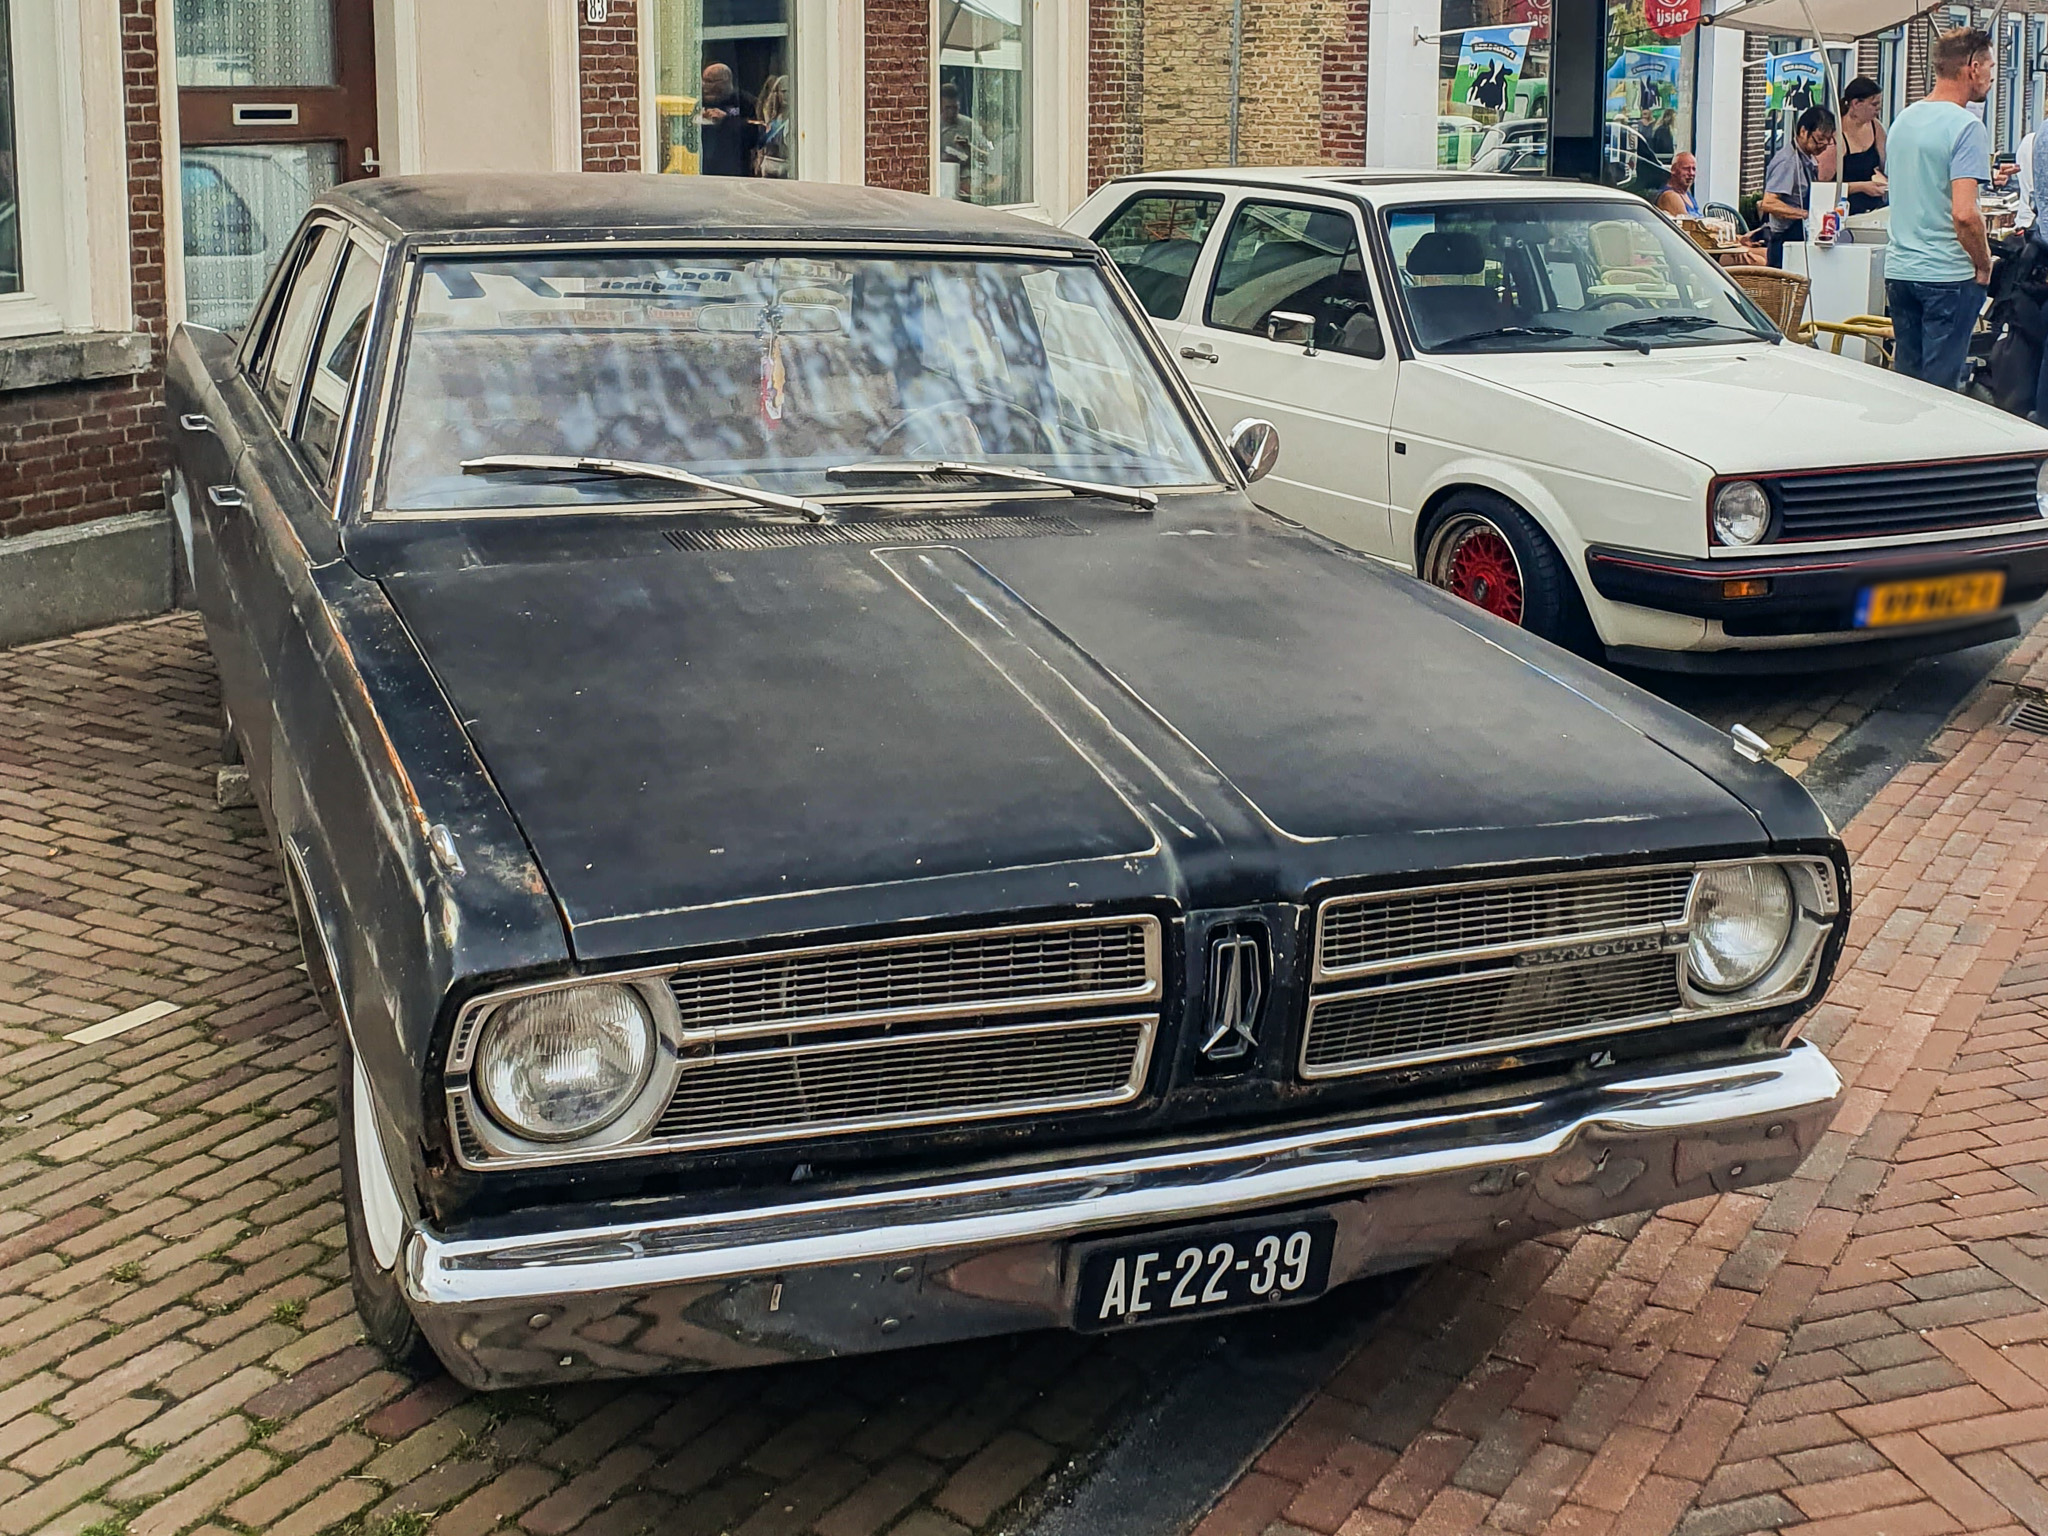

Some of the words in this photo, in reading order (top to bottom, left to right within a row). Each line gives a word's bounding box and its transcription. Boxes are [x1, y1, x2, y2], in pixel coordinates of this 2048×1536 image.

[590, 0, 604, 19] 83
[1656, 8, 1689, 27] ijsje?
[1520, 936, 1662, 967] PLYMOUTH
[1099, 1231, 1312, 1319] AE-22-39
